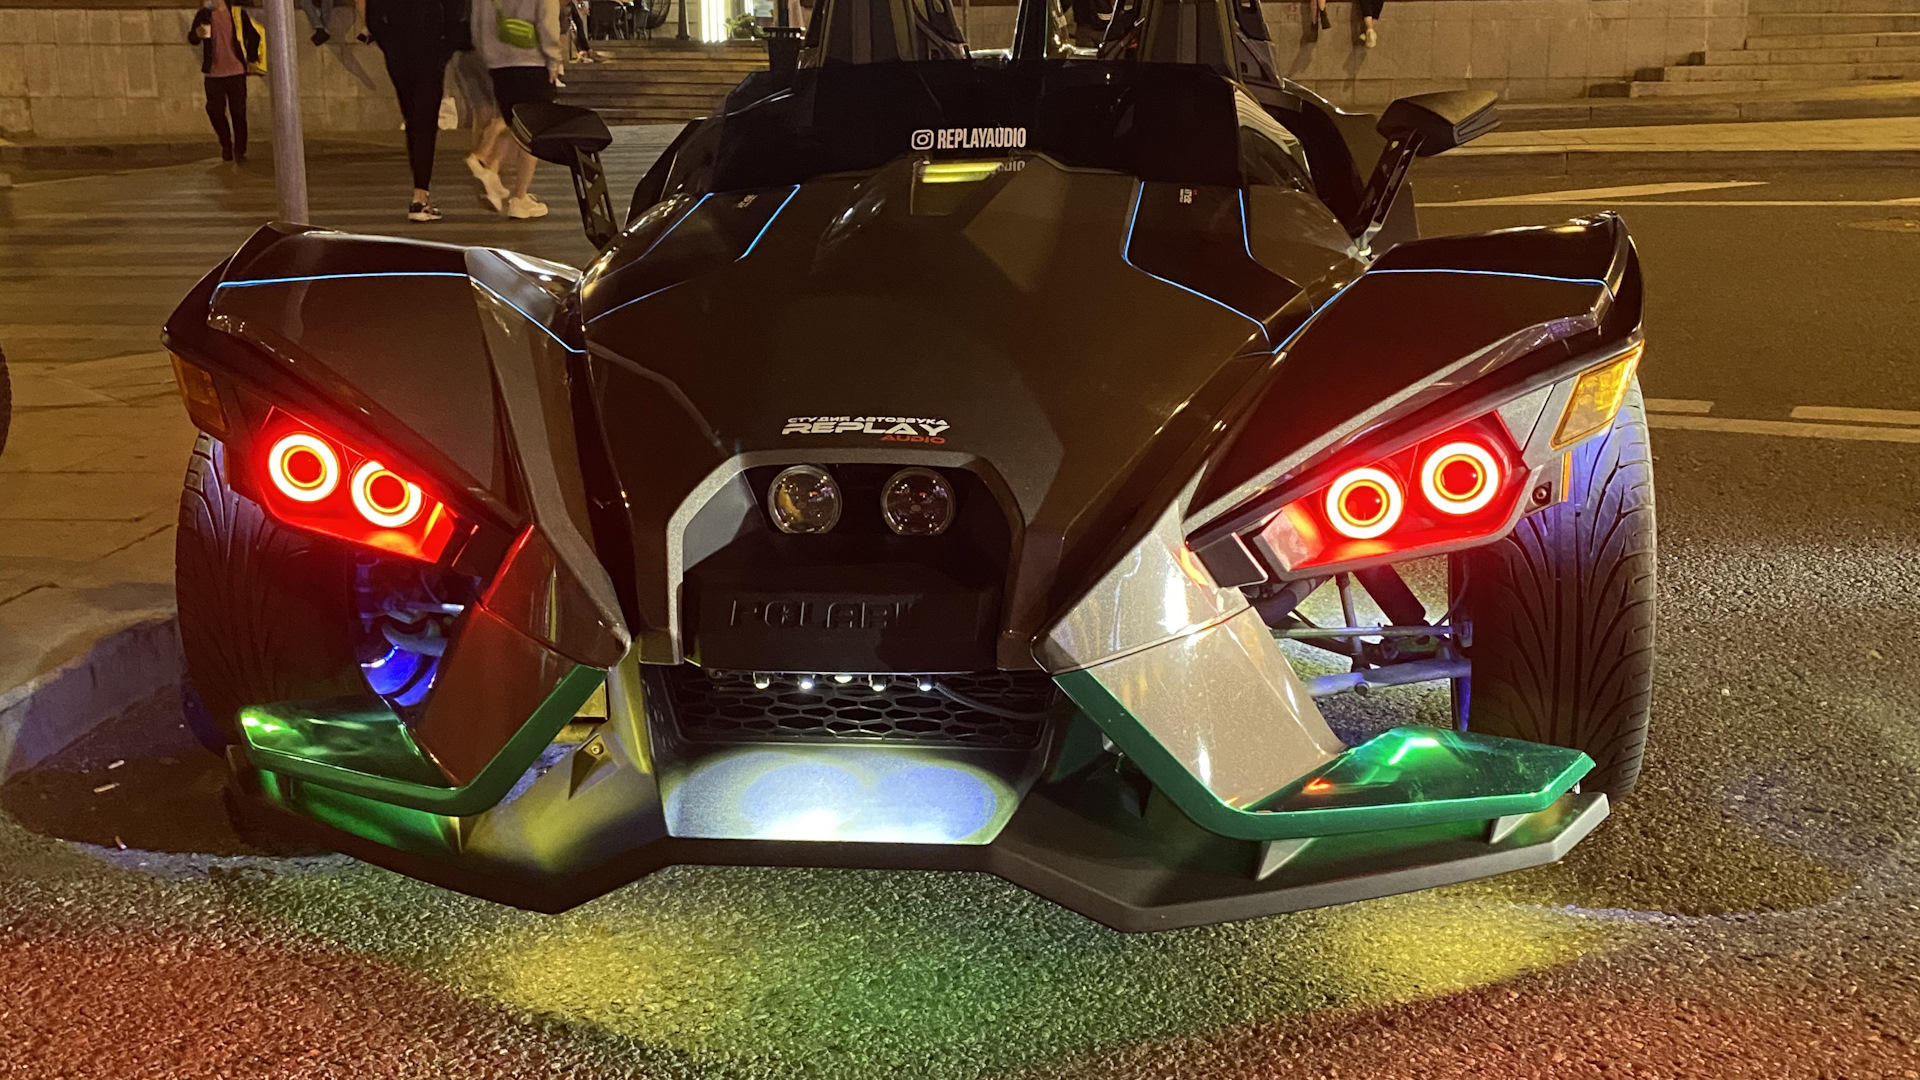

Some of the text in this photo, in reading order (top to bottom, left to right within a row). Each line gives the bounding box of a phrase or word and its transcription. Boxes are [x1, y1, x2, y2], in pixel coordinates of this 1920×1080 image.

[937, 127, 1027, 149] REPLAYAUDIO
[853, 416, 948, 426] АВТОЗВУКА
[781, 421, 951, 437] REPLAY
[880, 434, 946, 444] AUDIO
